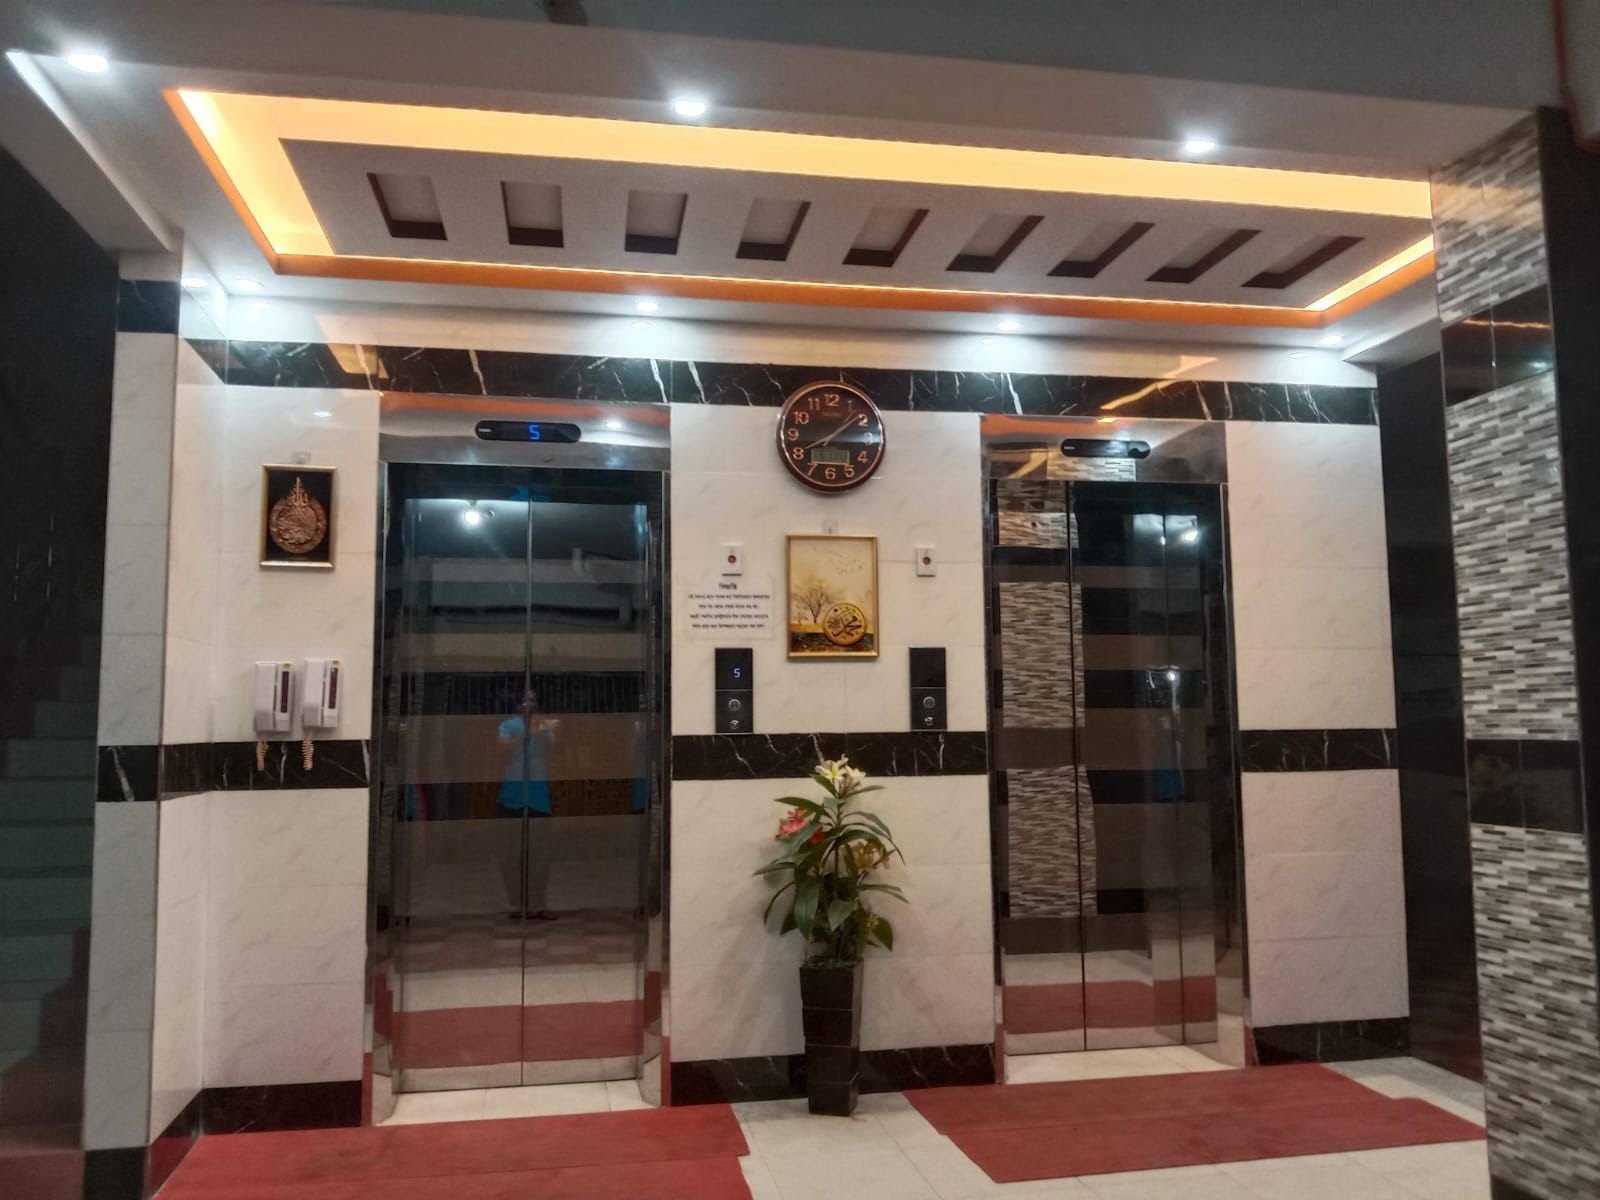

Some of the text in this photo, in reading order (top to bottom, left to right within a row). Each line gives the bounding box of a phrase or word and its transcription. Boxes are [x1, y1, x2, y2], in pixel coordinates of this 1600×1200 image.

[808, 398, 820, 410] 11
[824, 394, 840, 407] 12
[847, 400, 853, 410] 1
[793, 411, 809, 424] 10
[858, 413, 868, 427] 2
[529, 424, 540, 440] 5
[787, 428, 799, 441] 9
[864, 432, 873, 445] 3
[793, 447, 804, 460] 8
[857, 450, 868, 463] 4
[807, 463, 818, 476] 7
[825, 467, 836, 480] 6
[844, 464, 855, 477] 5
[733, 668, 741, 678] 5
